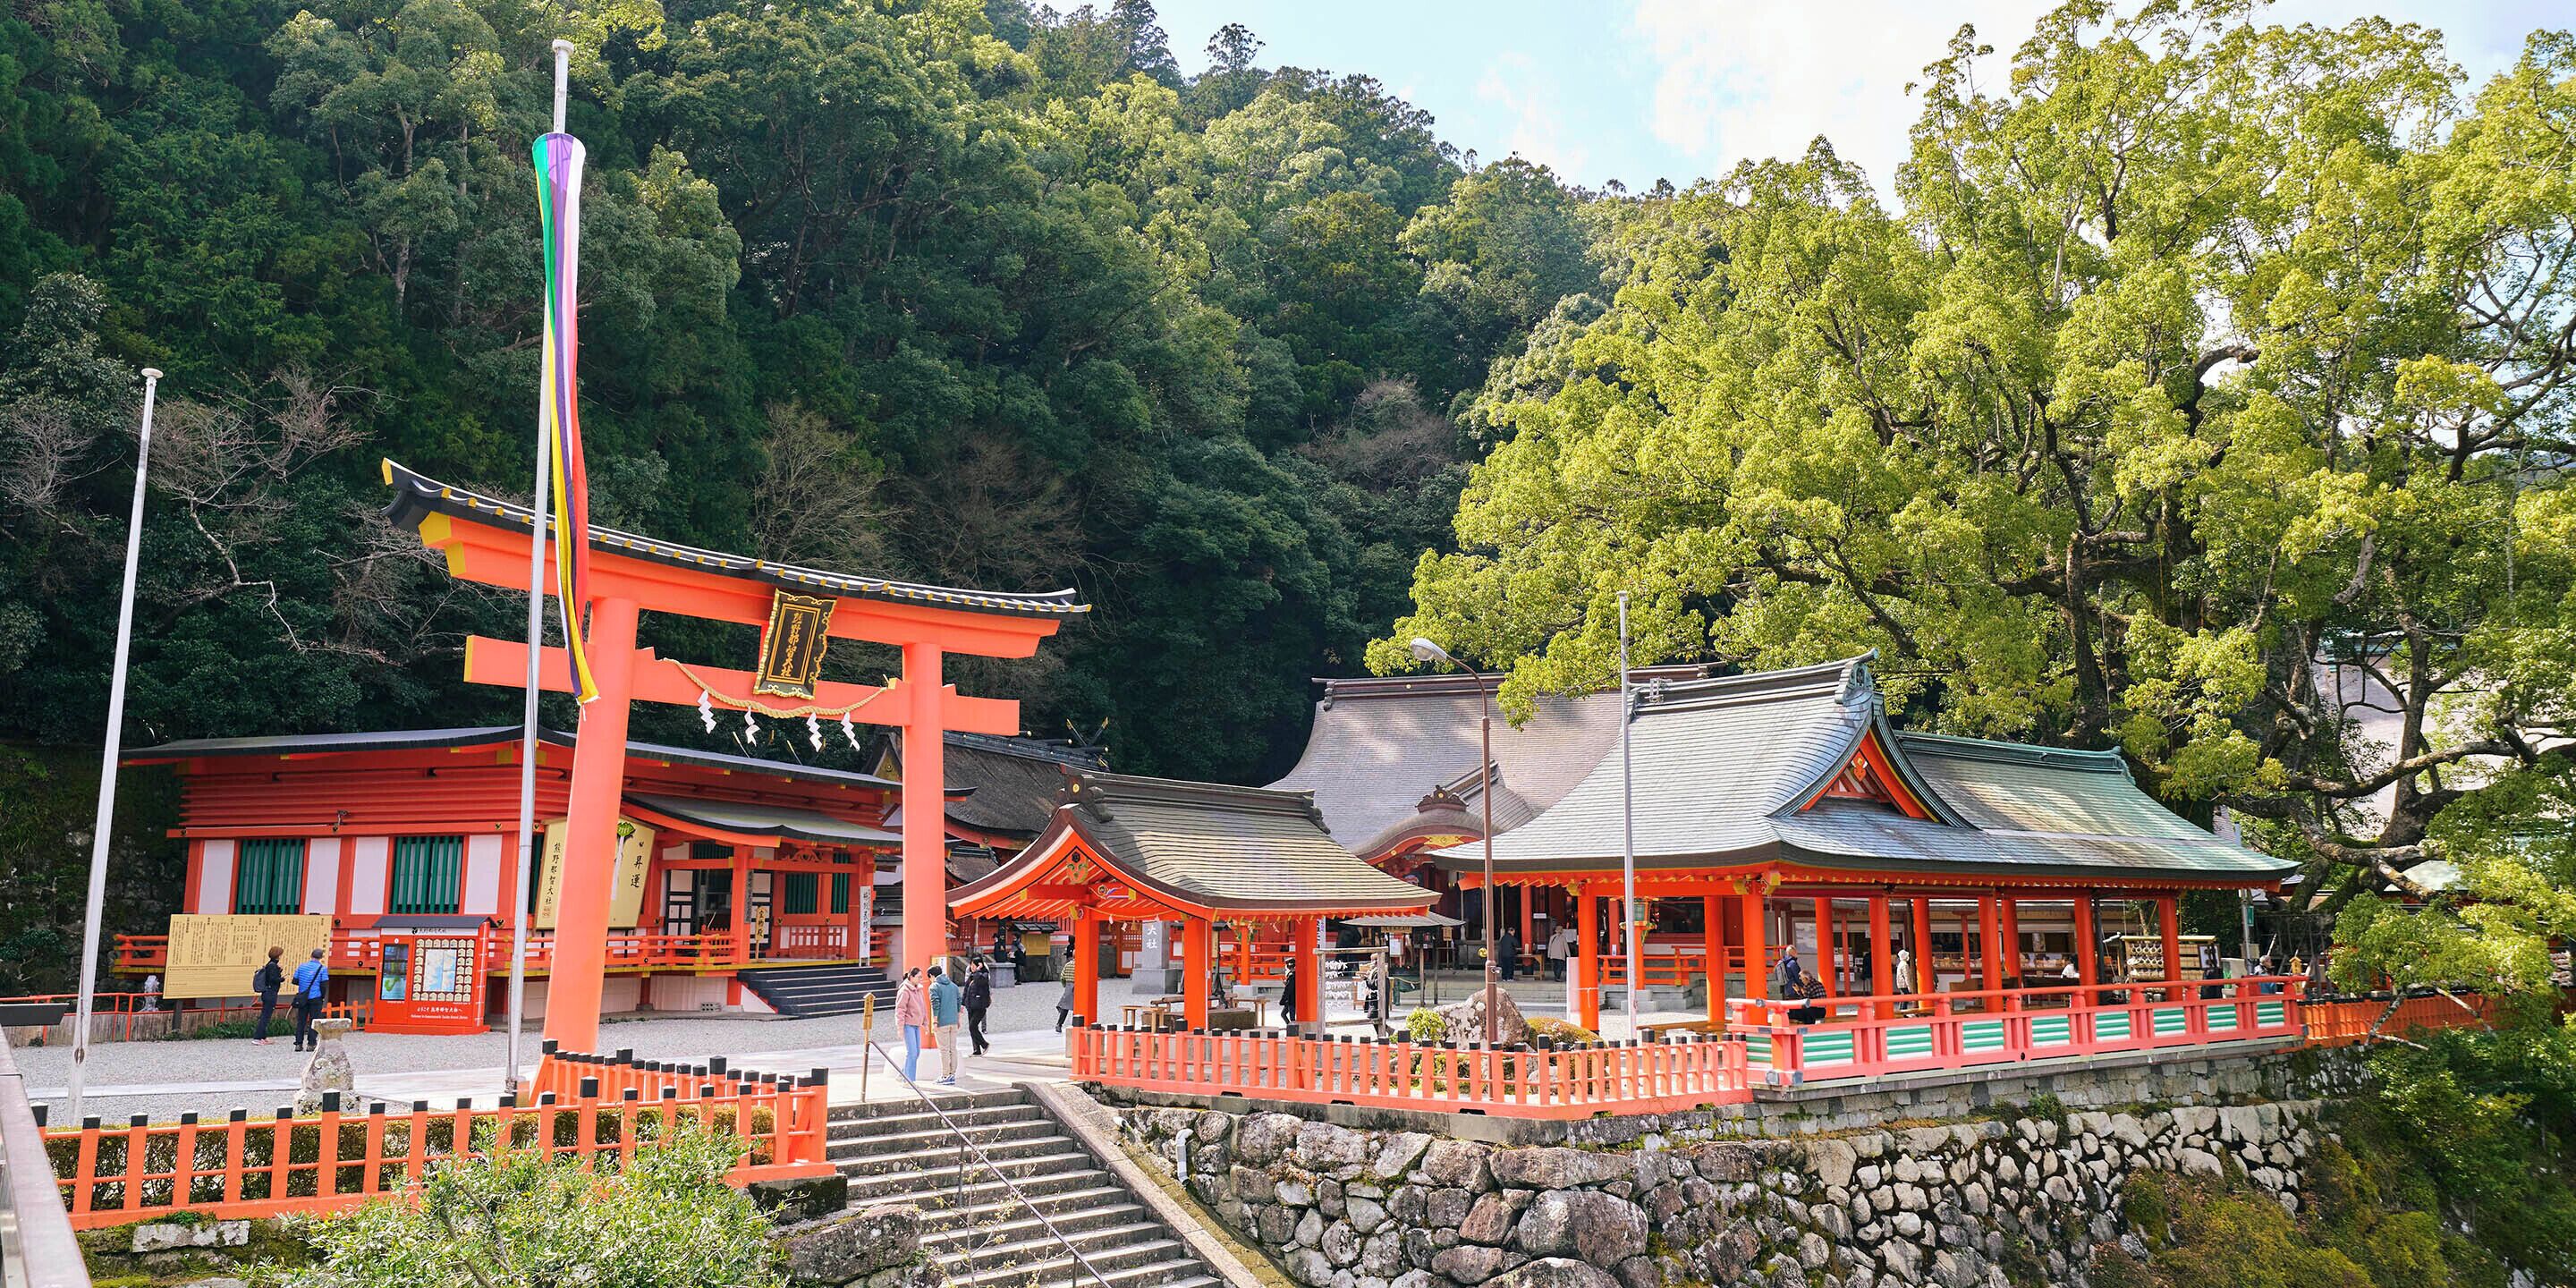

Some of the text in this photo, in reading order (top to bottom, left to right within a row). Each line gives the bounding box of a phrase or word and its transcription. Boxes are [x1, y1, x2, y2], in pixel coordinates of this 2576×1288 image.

[781, 612, 803, 677] 熊野那智大社
[545, 842, 561, 905] 熊野那智大社
[631, 855, 643, 888] 昇運
[1146, 925, 1157, 949] 大社
